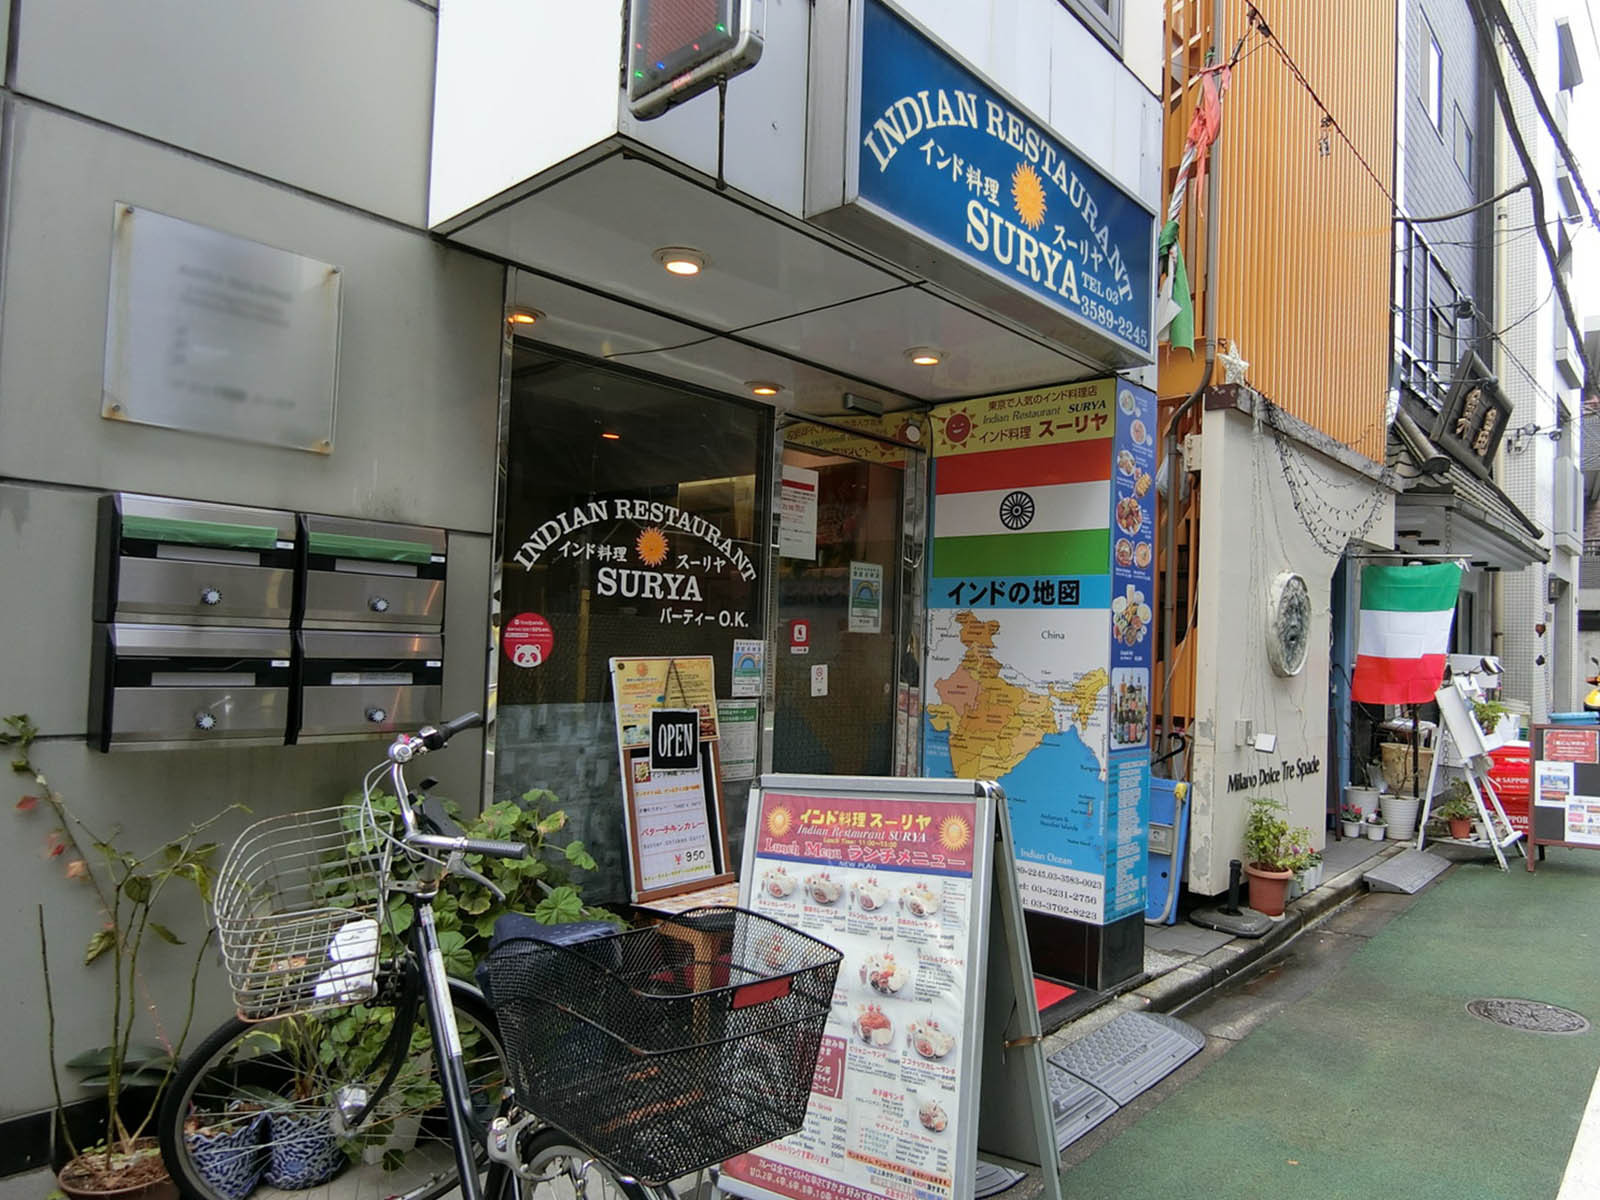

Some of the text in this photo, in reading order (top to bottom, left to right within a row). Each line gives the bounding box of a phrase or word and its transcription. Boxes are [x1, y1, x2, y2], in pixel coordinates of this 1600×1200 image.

[920, 138, 1000, 207] インド料理
[864, 88, 1133, 302] INDIAN RESTAURANT
[966, 199, 1081, 305] SURYA
[1053, 224, 1104, 273] スーリヤ
[1081, 271, 1120, 307] TEL 03
[1081, 295, 1149, 349] 3589-2245
[987, 384, 1098, 412] 東京で人気のインド料理店
[982, 409, 1010, 425] Indian
[1012, 406, 1062, 422] Restaurant
[1067, 400, 1107, 415] SURYA
[978, 412, 1109, 445] インド料理 スーリヤ
[513, 499, 608, 572] INDIAN
[614, 498, 758, 583] RESTAURANT
[558, 540, 628, 563] インド料理
[676, 553, 727, 574] スーリヤ
[597, 566, 703, 602] SURYA
[948, 579, 1081, 607] インドの地図
[718, 609, 750, 628] O.K.
[1041, 630, 1065, 641] China
[658, 723, 694, 758] OPEN
[1227, 754, 1320, 794] Milano Dolce Tre Spade
[800, 808, 932, 831] インド料理 スーリヤ
[797, 825, 927, 843] Indian Restaurant SURYA
[685, 850, 706, 863] 950
[848, 846, 967, 869] ランチメニュー
[1020, 848, 1045, 860] Indian
